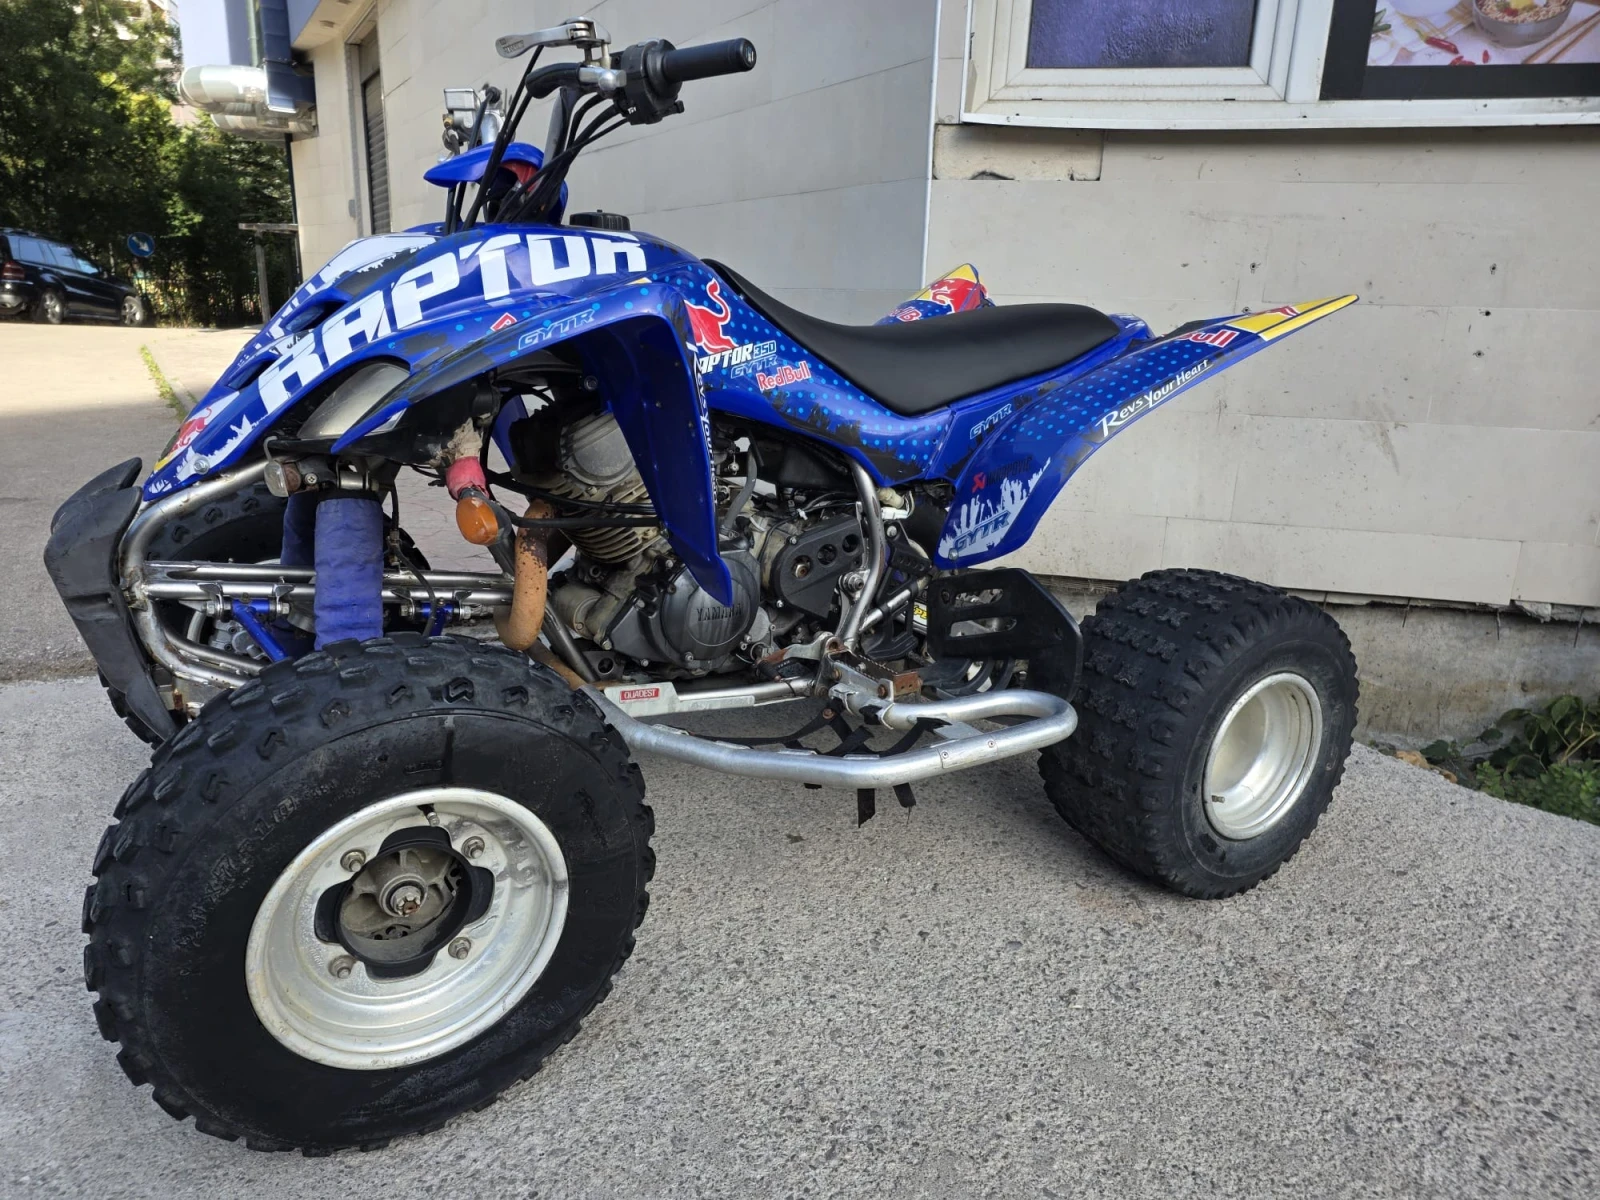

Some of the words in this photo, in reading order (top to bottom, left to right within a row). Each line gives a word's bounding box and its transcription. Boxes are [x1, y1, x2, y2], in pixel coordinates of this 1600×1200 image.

[258, 233, 648, 416] RAPTOR
[518, 308, 595, 350] GYTR
[699, 343, 754, 375] APTOR
[753, 340, 777, 359] 350
[730, 354, 779, 379] GYTR
[1095, 397, 1144, 438] Revs
[1143, 380, 1176, 409] Your
[1175, 359, 1209, 386] Heart
[969, 403, 1013, 440] GYTR
[953, 509, 1012, 552] GYTR
